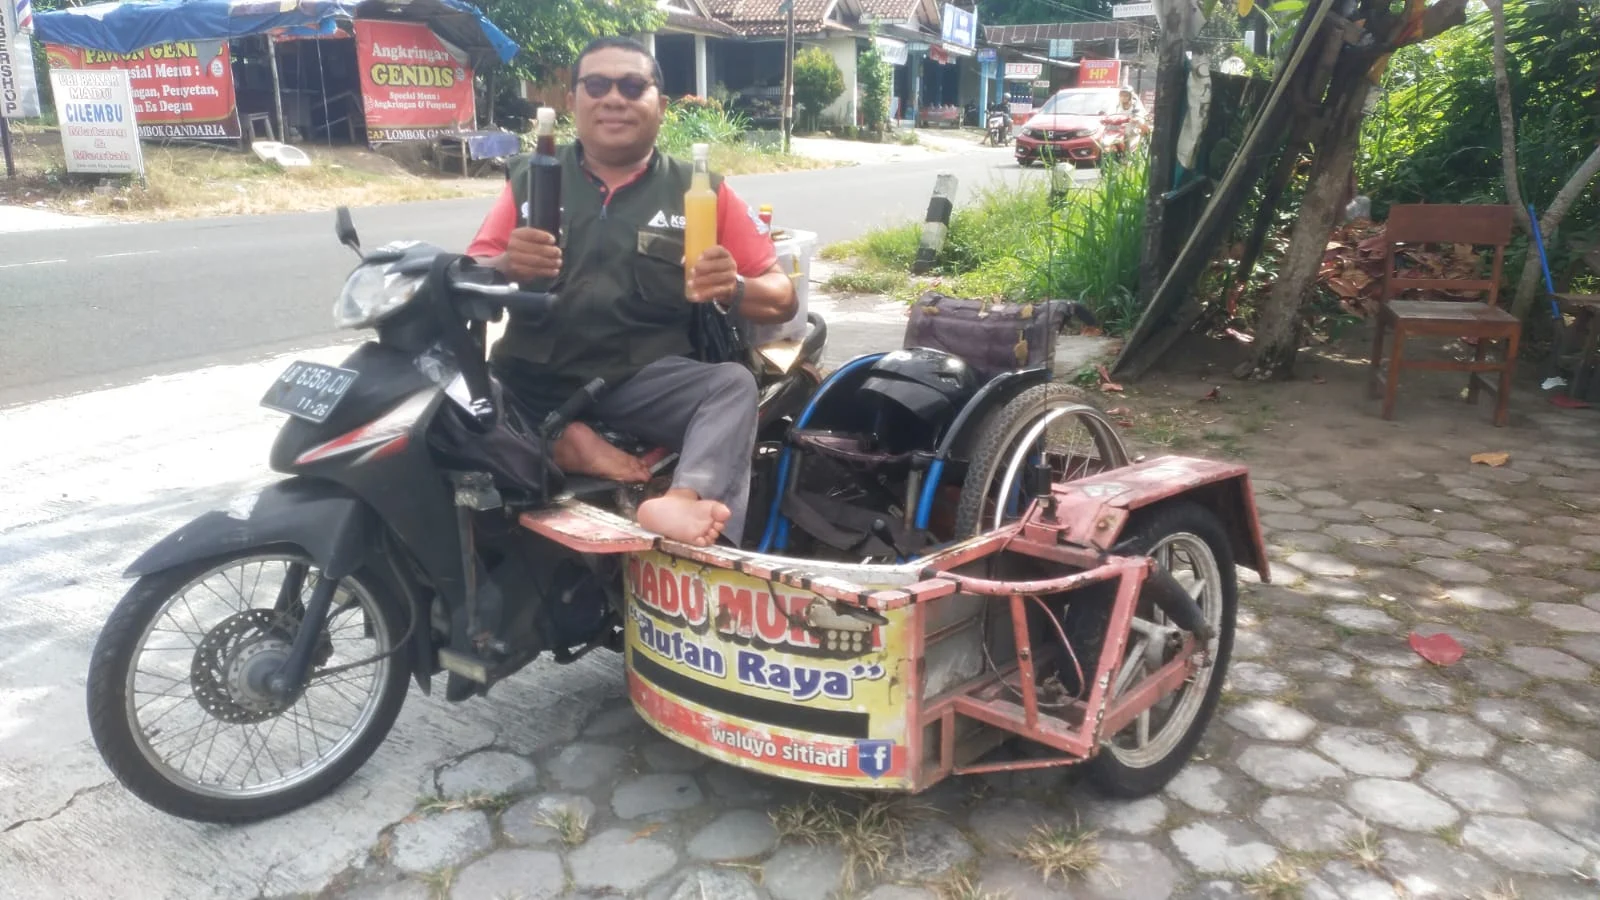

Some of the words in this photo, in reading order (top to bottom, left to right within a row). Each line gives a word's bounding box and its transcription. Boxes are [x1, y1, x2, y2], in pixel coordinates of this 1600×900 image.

[155, 64, 192, 78] Menu
[371, 64, 454, 87] GENDIS
[1088, 69, 1108, 80] HP
[162, 85, 219, 98] Penyetan,
[65, 103, 123, 122] CILEMBU
[160, 101, 193, 114] Degan
[165, 124, 226, 137] GANDARIA
[711, 725, 777, 758] waluyo
[782, 743, 848, 768] sitiadi
